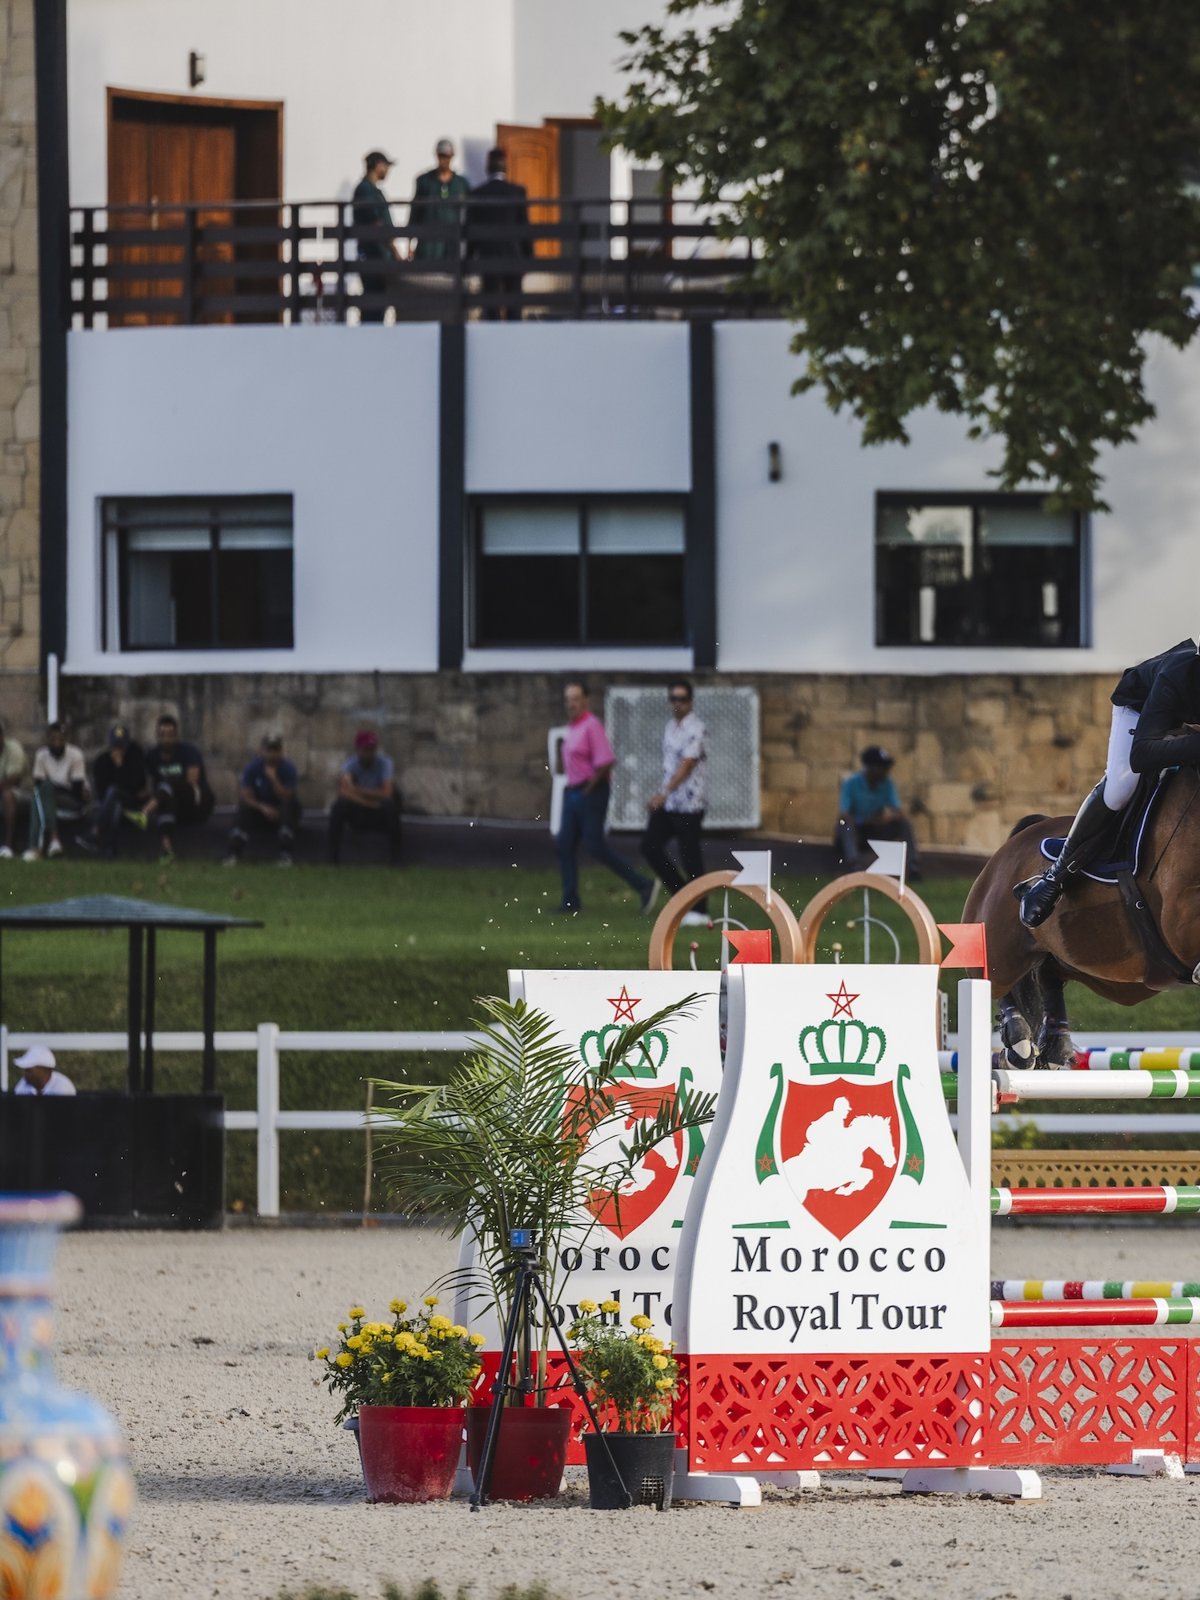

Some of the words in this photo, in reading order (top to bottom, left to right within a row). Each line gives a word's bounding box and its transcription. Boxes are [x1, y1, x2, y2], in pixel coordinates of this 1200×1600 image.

[558, 1245, 671, 1272] oroc
[731, 1235, 946, 1273] Morocco
[731, 1290, 840, 1344] Royal
[851, 1292, 948, 1331] Tour
